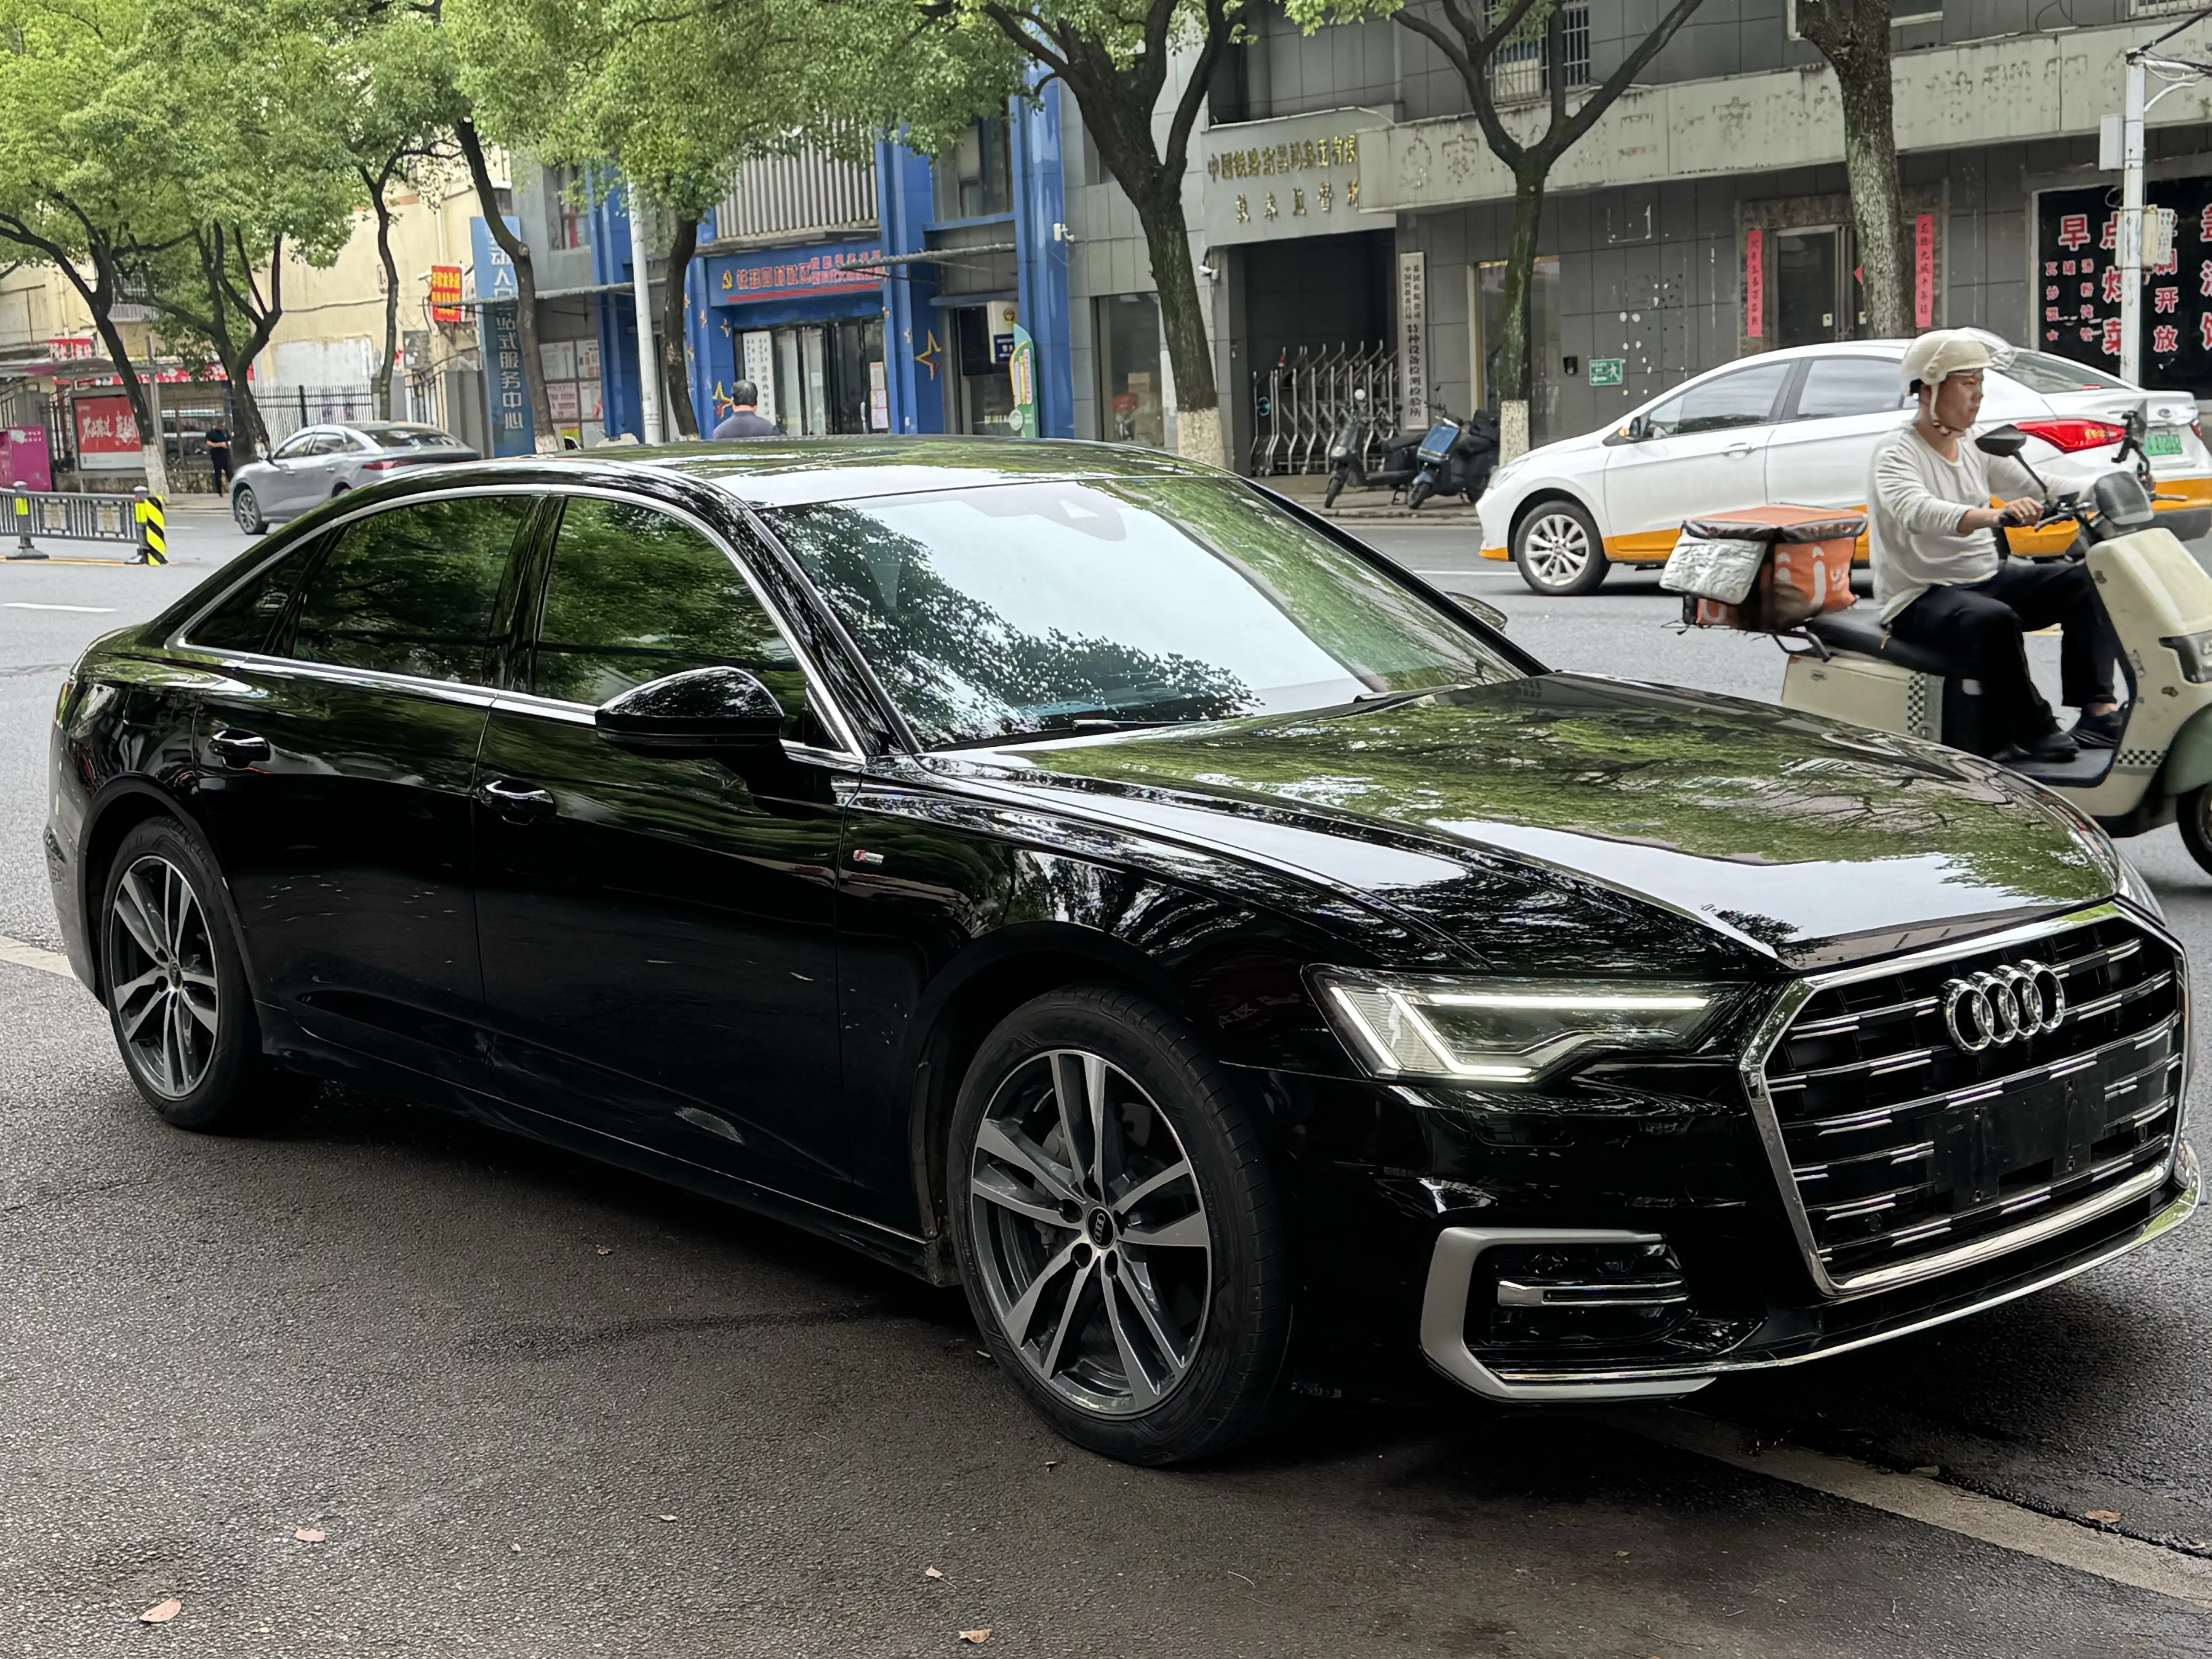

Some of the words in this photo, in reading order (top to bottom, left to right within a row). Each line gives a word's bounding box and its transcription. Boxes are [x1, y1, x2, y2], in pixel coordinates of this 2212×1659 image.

[489, 229, 524, 429] 动人口一站式服务中心
